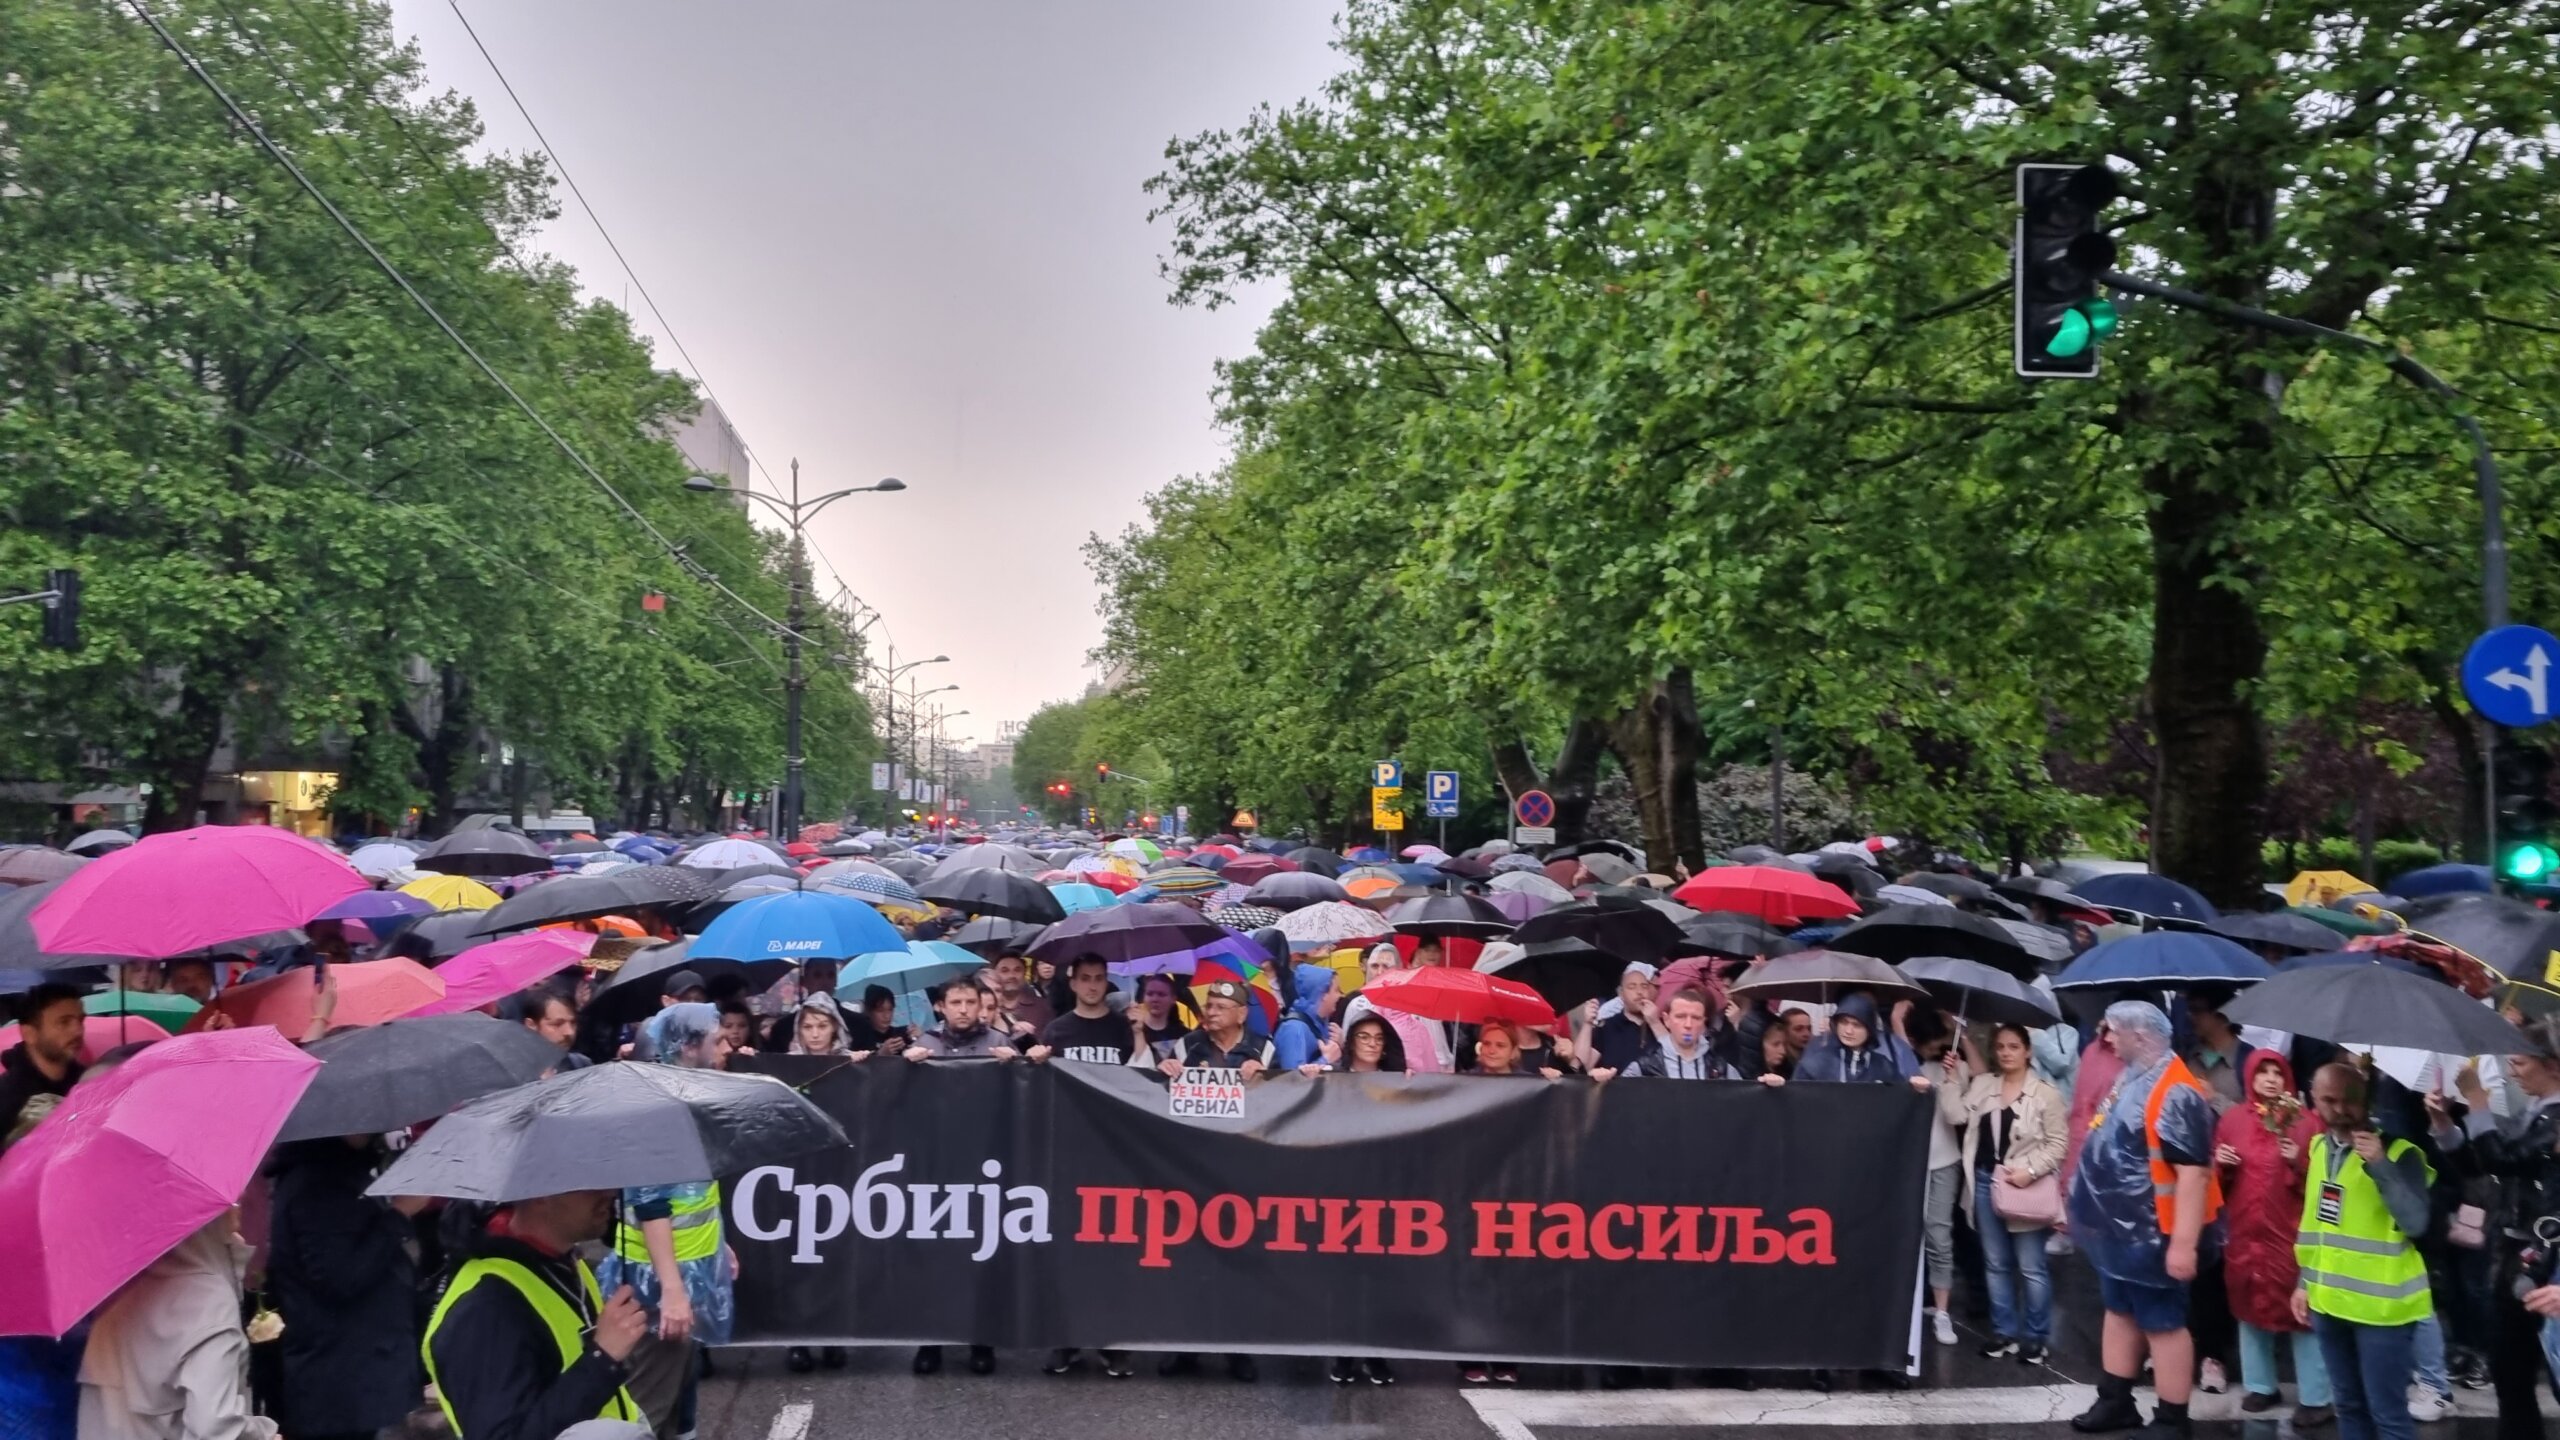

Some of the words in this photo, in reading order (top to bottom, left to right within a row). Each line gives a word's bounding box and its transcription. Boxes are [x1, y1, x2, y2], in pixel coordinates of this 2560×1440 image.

[1378, 764, 1395, 785] P
[1434, 775, 1452, 798] P
[784, 940, 823, 951] MAPEI
[1063, 1046, 1121, 1064] KRIK
[1191, 1086, 1242, 1099] ЦЕЛА
[1172, 1099, 1240, 1114] СРБИЈА
[732, 1153, 1053, 1264] Србија
[1075, 1186, 1448, 1268] против
[1471, 1201, 1837, 1265] насиља
